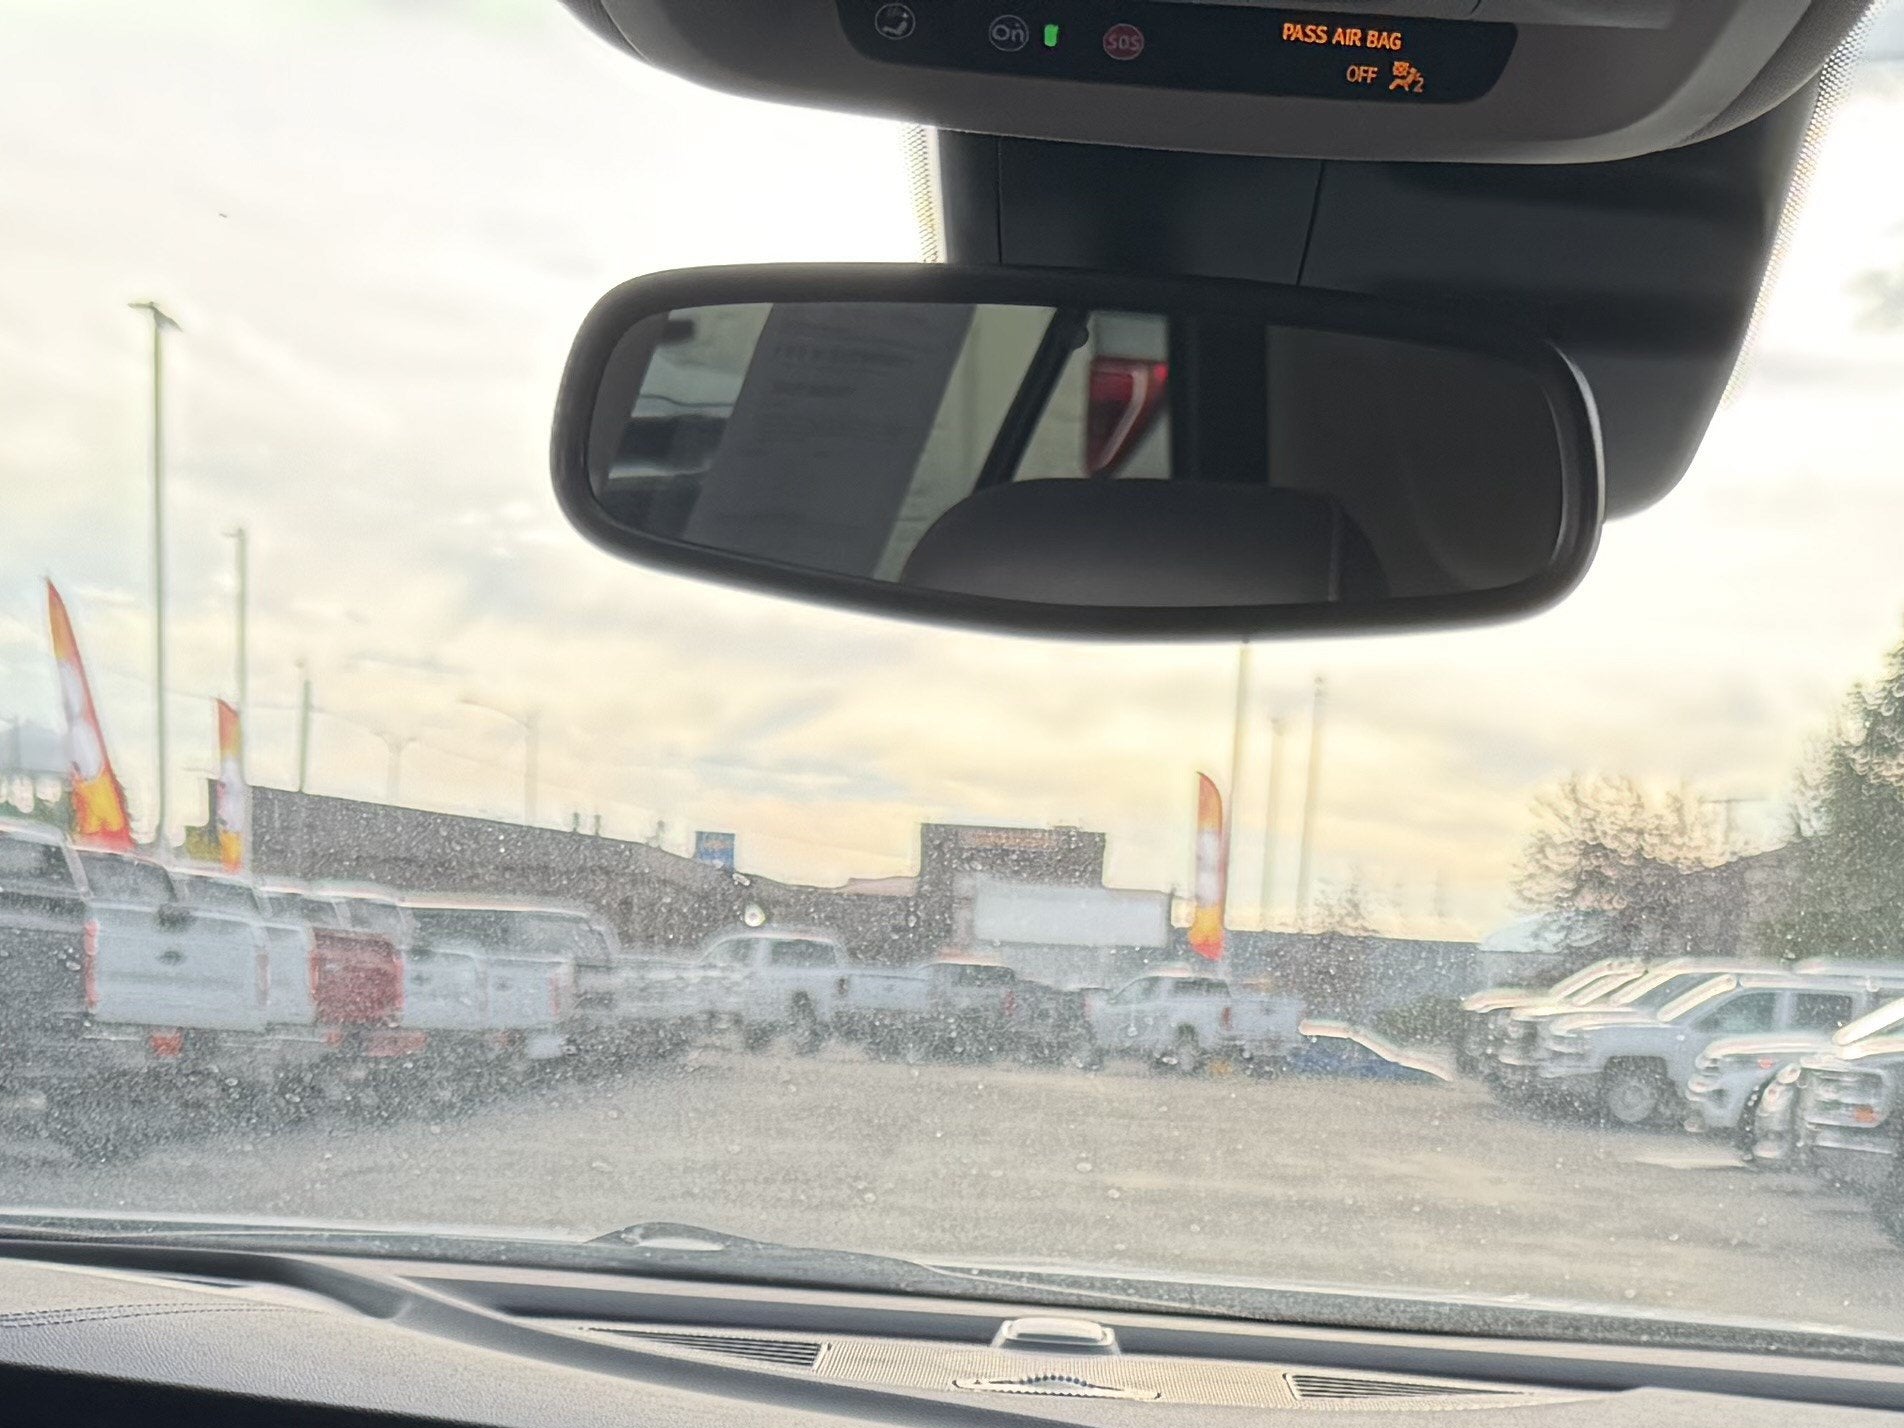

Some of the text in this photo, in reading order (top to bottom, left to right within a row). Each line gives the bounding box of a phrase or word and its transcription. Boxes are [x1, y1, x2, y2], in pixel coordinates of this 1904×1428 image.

[1105, 32, 1141, 54] SOS
[1281, 22, 1402, 52] PASS AIR BAG
[1346, 64, 1378, 84] OFF
